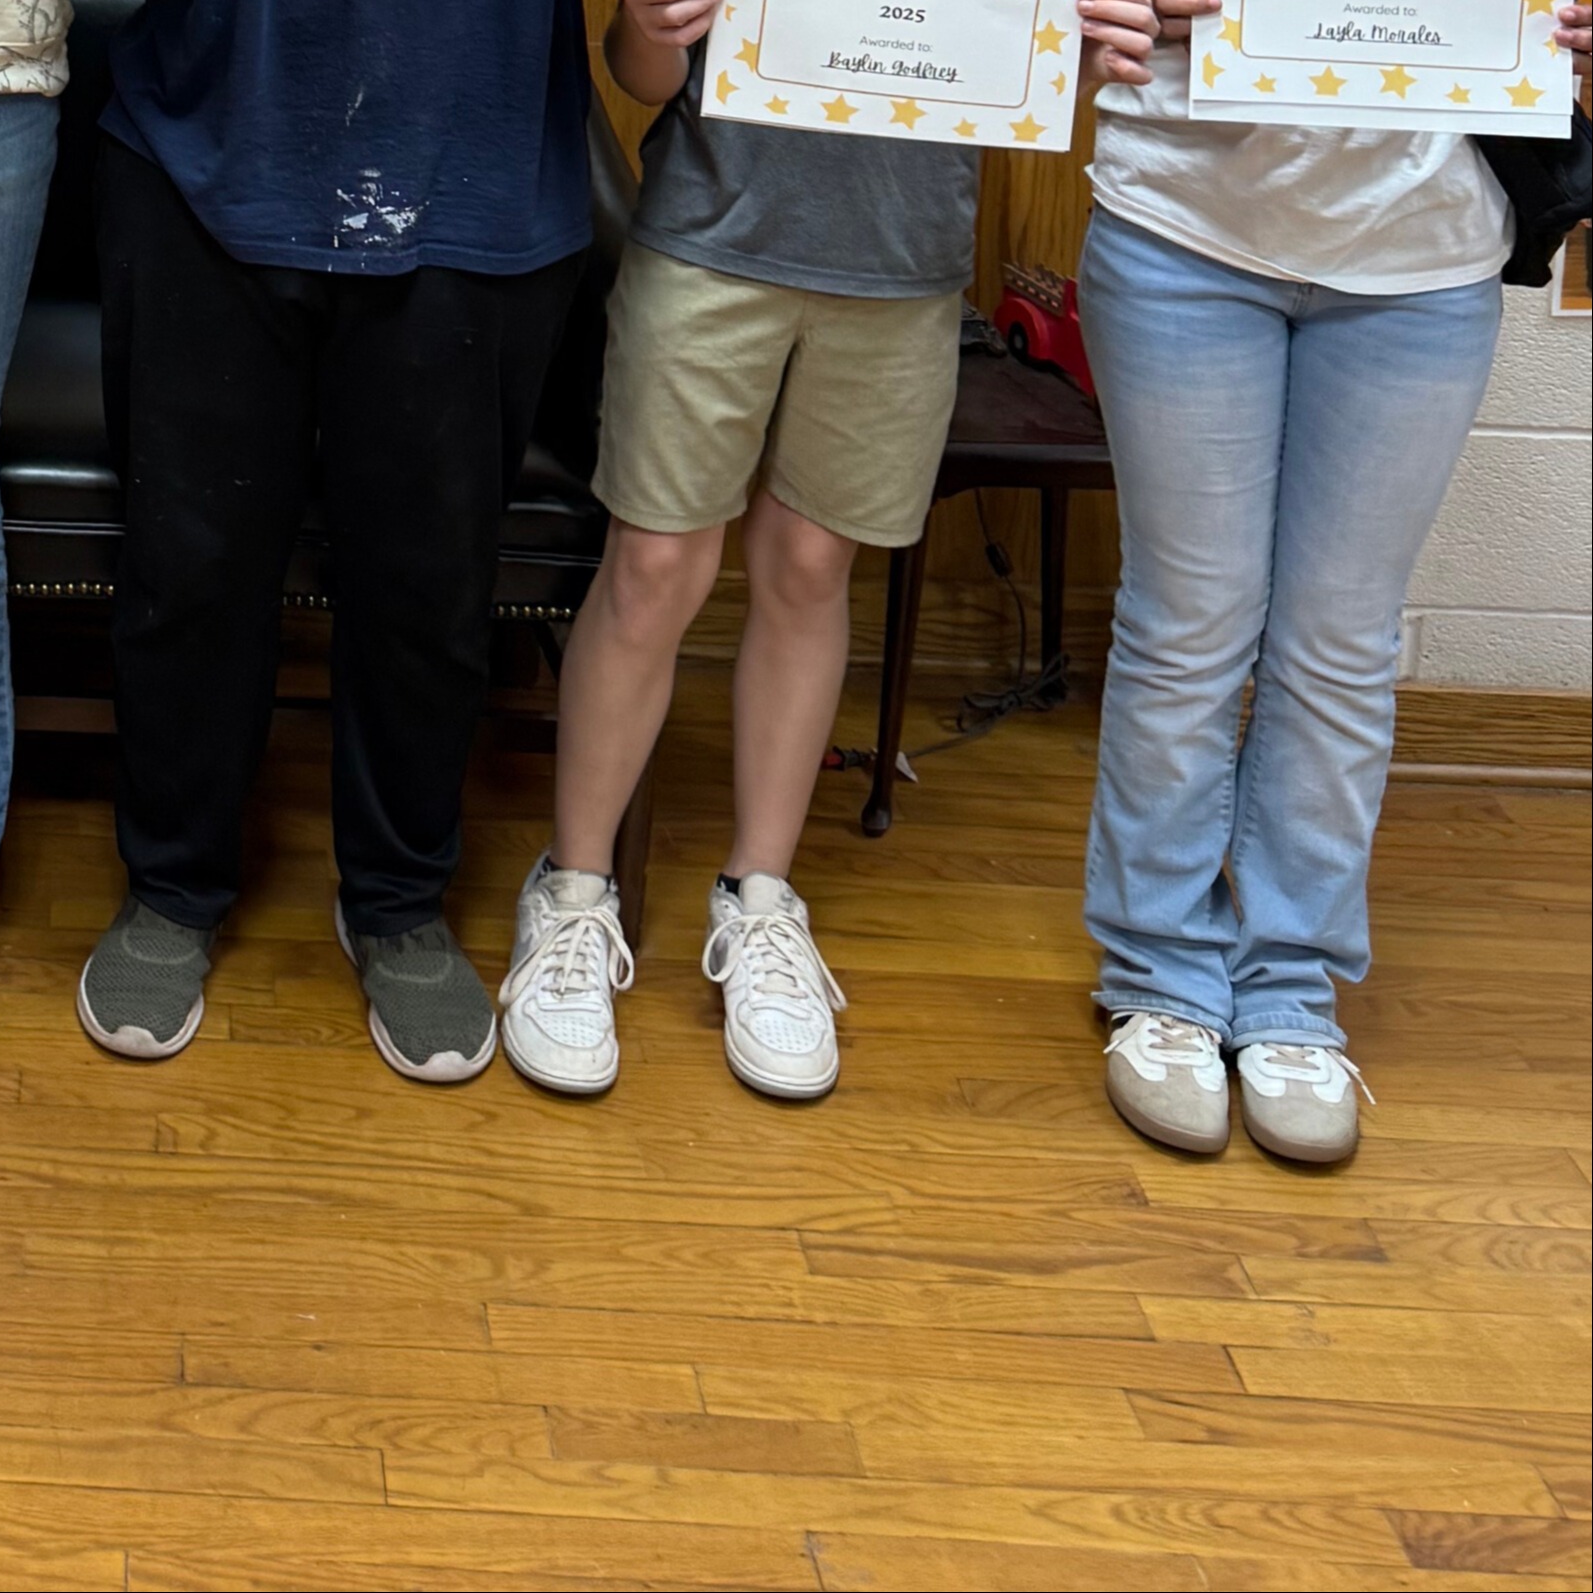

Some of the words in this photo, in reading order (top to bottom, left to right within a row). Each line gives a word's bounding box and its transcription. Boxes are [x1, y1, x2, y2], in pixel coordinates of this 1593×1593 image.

[879, 6, 926, 23] 2025
[1342, 2, 1400, 16] Awarded
[1313, 22, 1365, 44] Layla
[1370, 26, 1443, 46] Morales
[859, 35, 916, 50] Awarded
